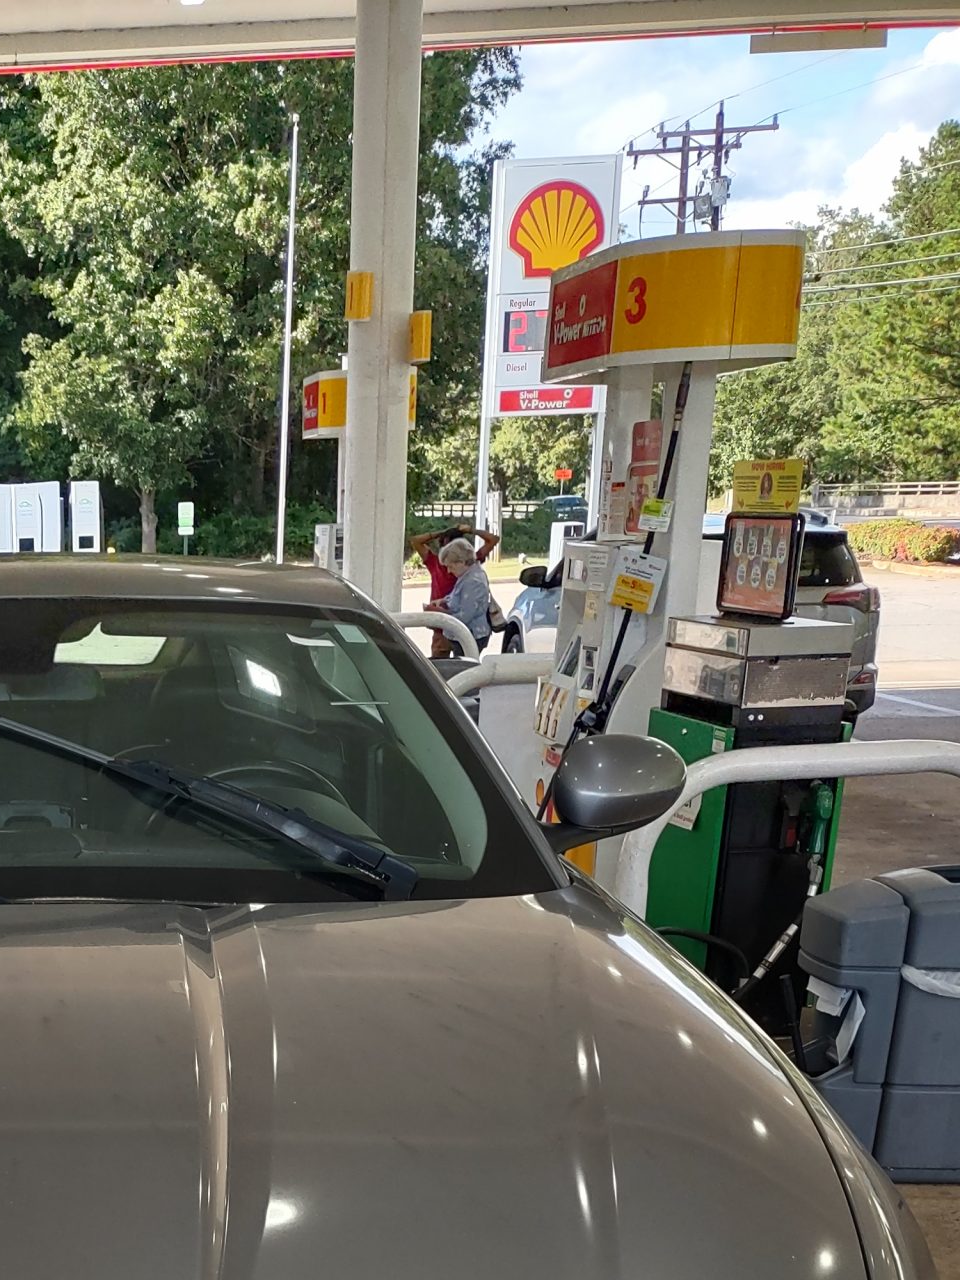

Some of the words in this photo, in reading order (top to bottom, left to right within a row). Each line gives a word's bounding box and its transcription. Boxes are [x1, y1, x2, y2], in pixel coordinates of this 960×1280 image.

[509, 298, 536, 310] Regular
[624, 276, 647, 325] 3
[553, 321, 583, 345] V-Power
[506, 363, 527, 372] Diesel
[520, 390, 538, 399] Shell
[520, 399, 570, 410] V-Power
